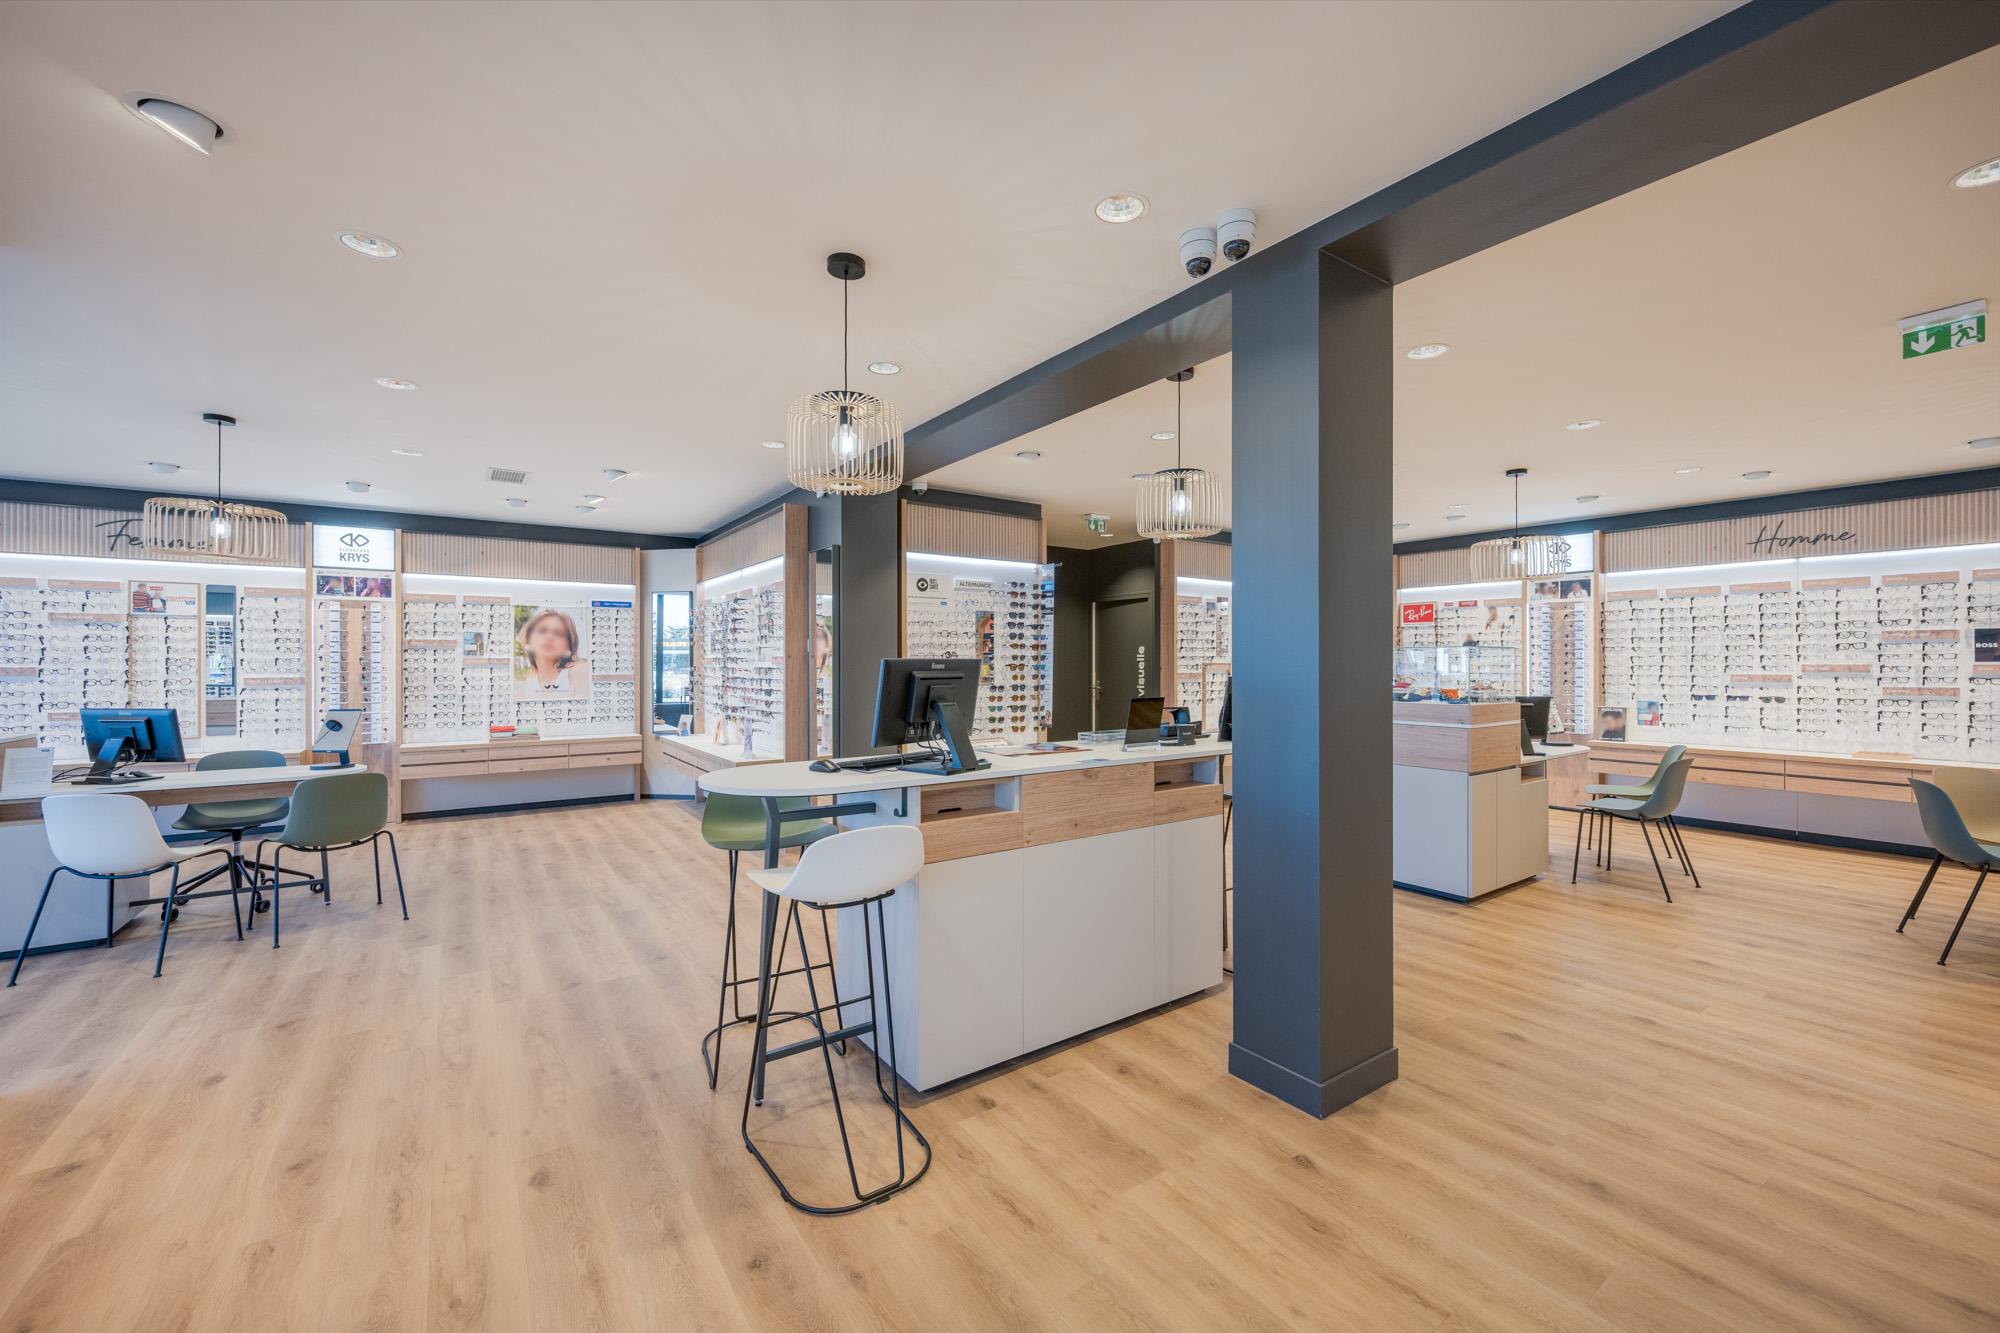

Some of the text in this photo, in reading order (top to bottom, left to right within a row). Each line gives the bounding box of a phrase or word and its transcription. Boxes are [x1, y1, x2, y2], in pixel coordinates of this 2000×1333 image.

[1746, 520, 1856, 554] Homme
[339, 552, 370, 563] KRYS
[959, 581, 992, 589] ALTERNANCE
[1404, 605, 1433, 621] Ray-Ban
[1136, 645, 1146, 697] visuelle
